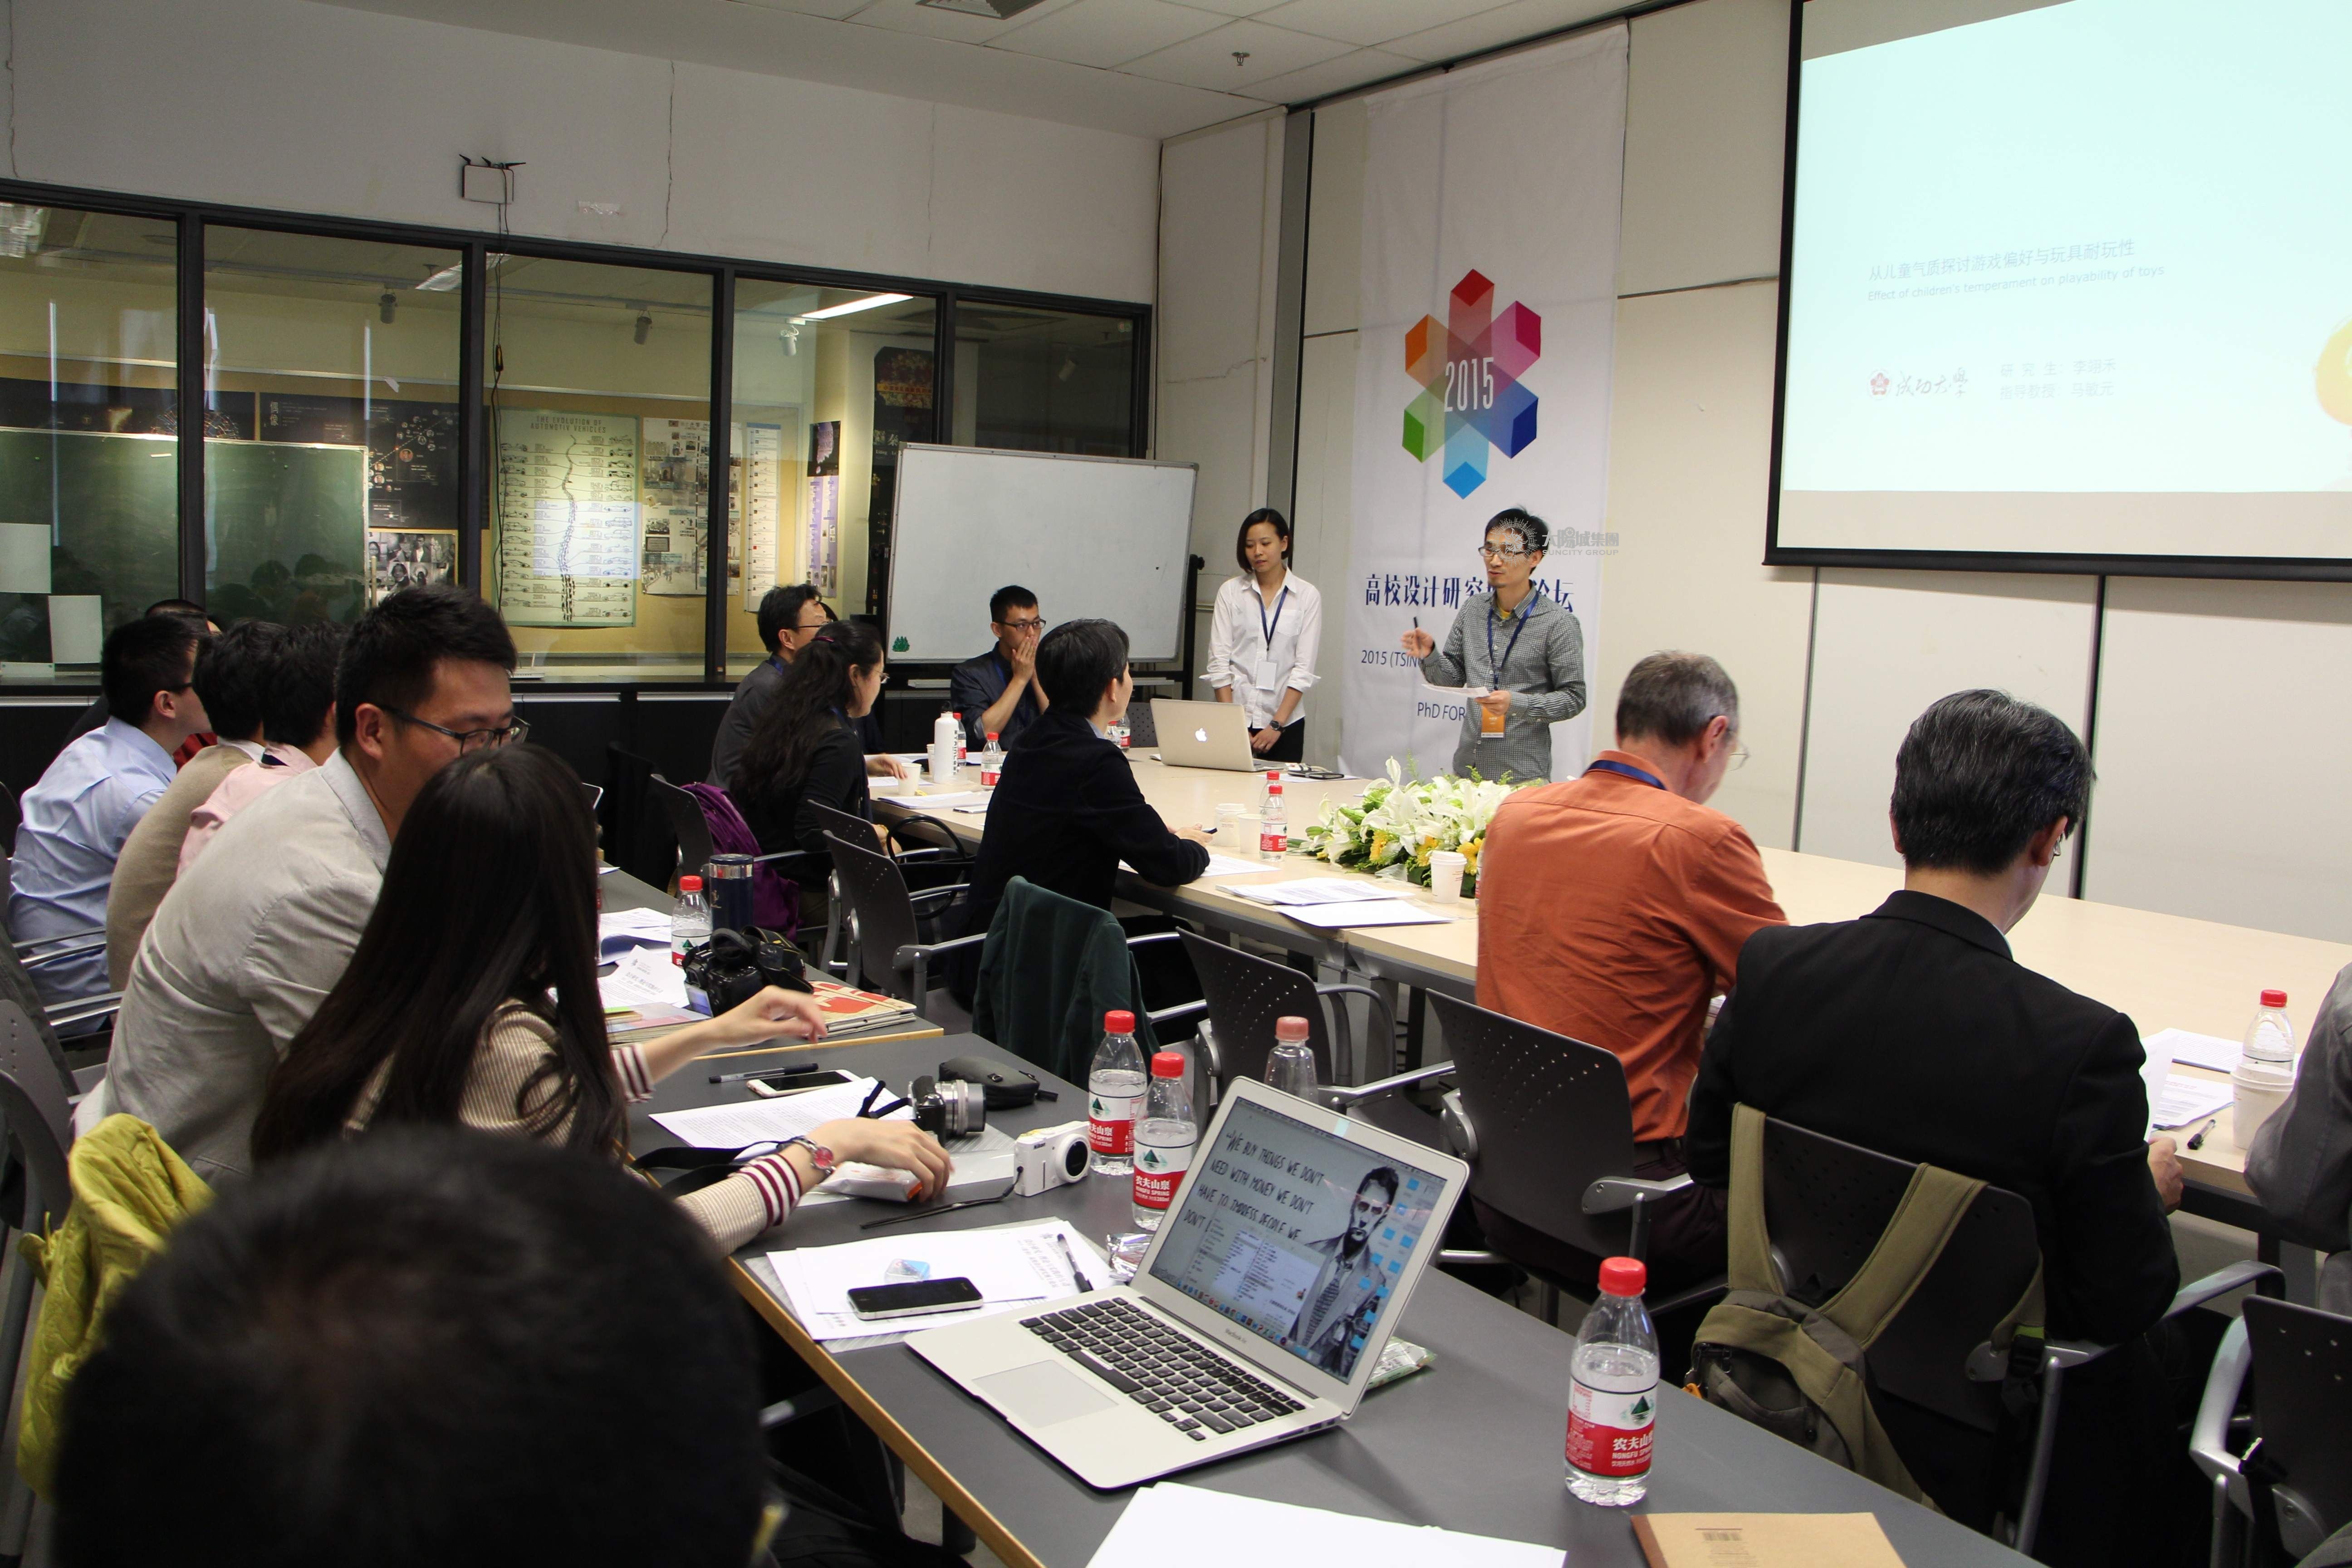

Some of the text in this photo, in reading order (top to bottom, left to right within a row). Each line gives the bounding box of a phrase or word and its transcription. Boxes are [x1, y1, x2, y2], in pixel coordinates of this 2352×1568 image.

[1869, 238, 2134, 281] 从儿童气质探讨游戏偏好与玩具耐玩性
[1868, 265, 2165, 301] Effect of children's temperament on playability of toys
[1444, 357, 1494, 412] 2015
[2071, 381, 2115, 398] 马敏元
[552, 416, 590, 425] EVOLUTION
[573, 425, 607, 433] VEHICLES
[1361, 650, 1387, 665] 2015
[1417, 702, 1440, 719] PhD
[1242, 1141, 1259, 1157] BUY
[1259, 1148, 1286, 1170] THINGS
[1286, 1159, 1301, 1176] WE
[1136, 1175, 1170, 1191] 农夫山泉
[1209, 1158, 1229, 1176] NEED
[1230, 1166, 1250, 1186] WITH
[1249, 1175, 1276, 1196] MONEY
[1276, 1188, 1290, 1205] WE
[1197, 1183, 1218, 1203] HAVE
[1217, 1193, 1230, 1207] TO
[1612, 1450, 1639, 1460] NONGFU
